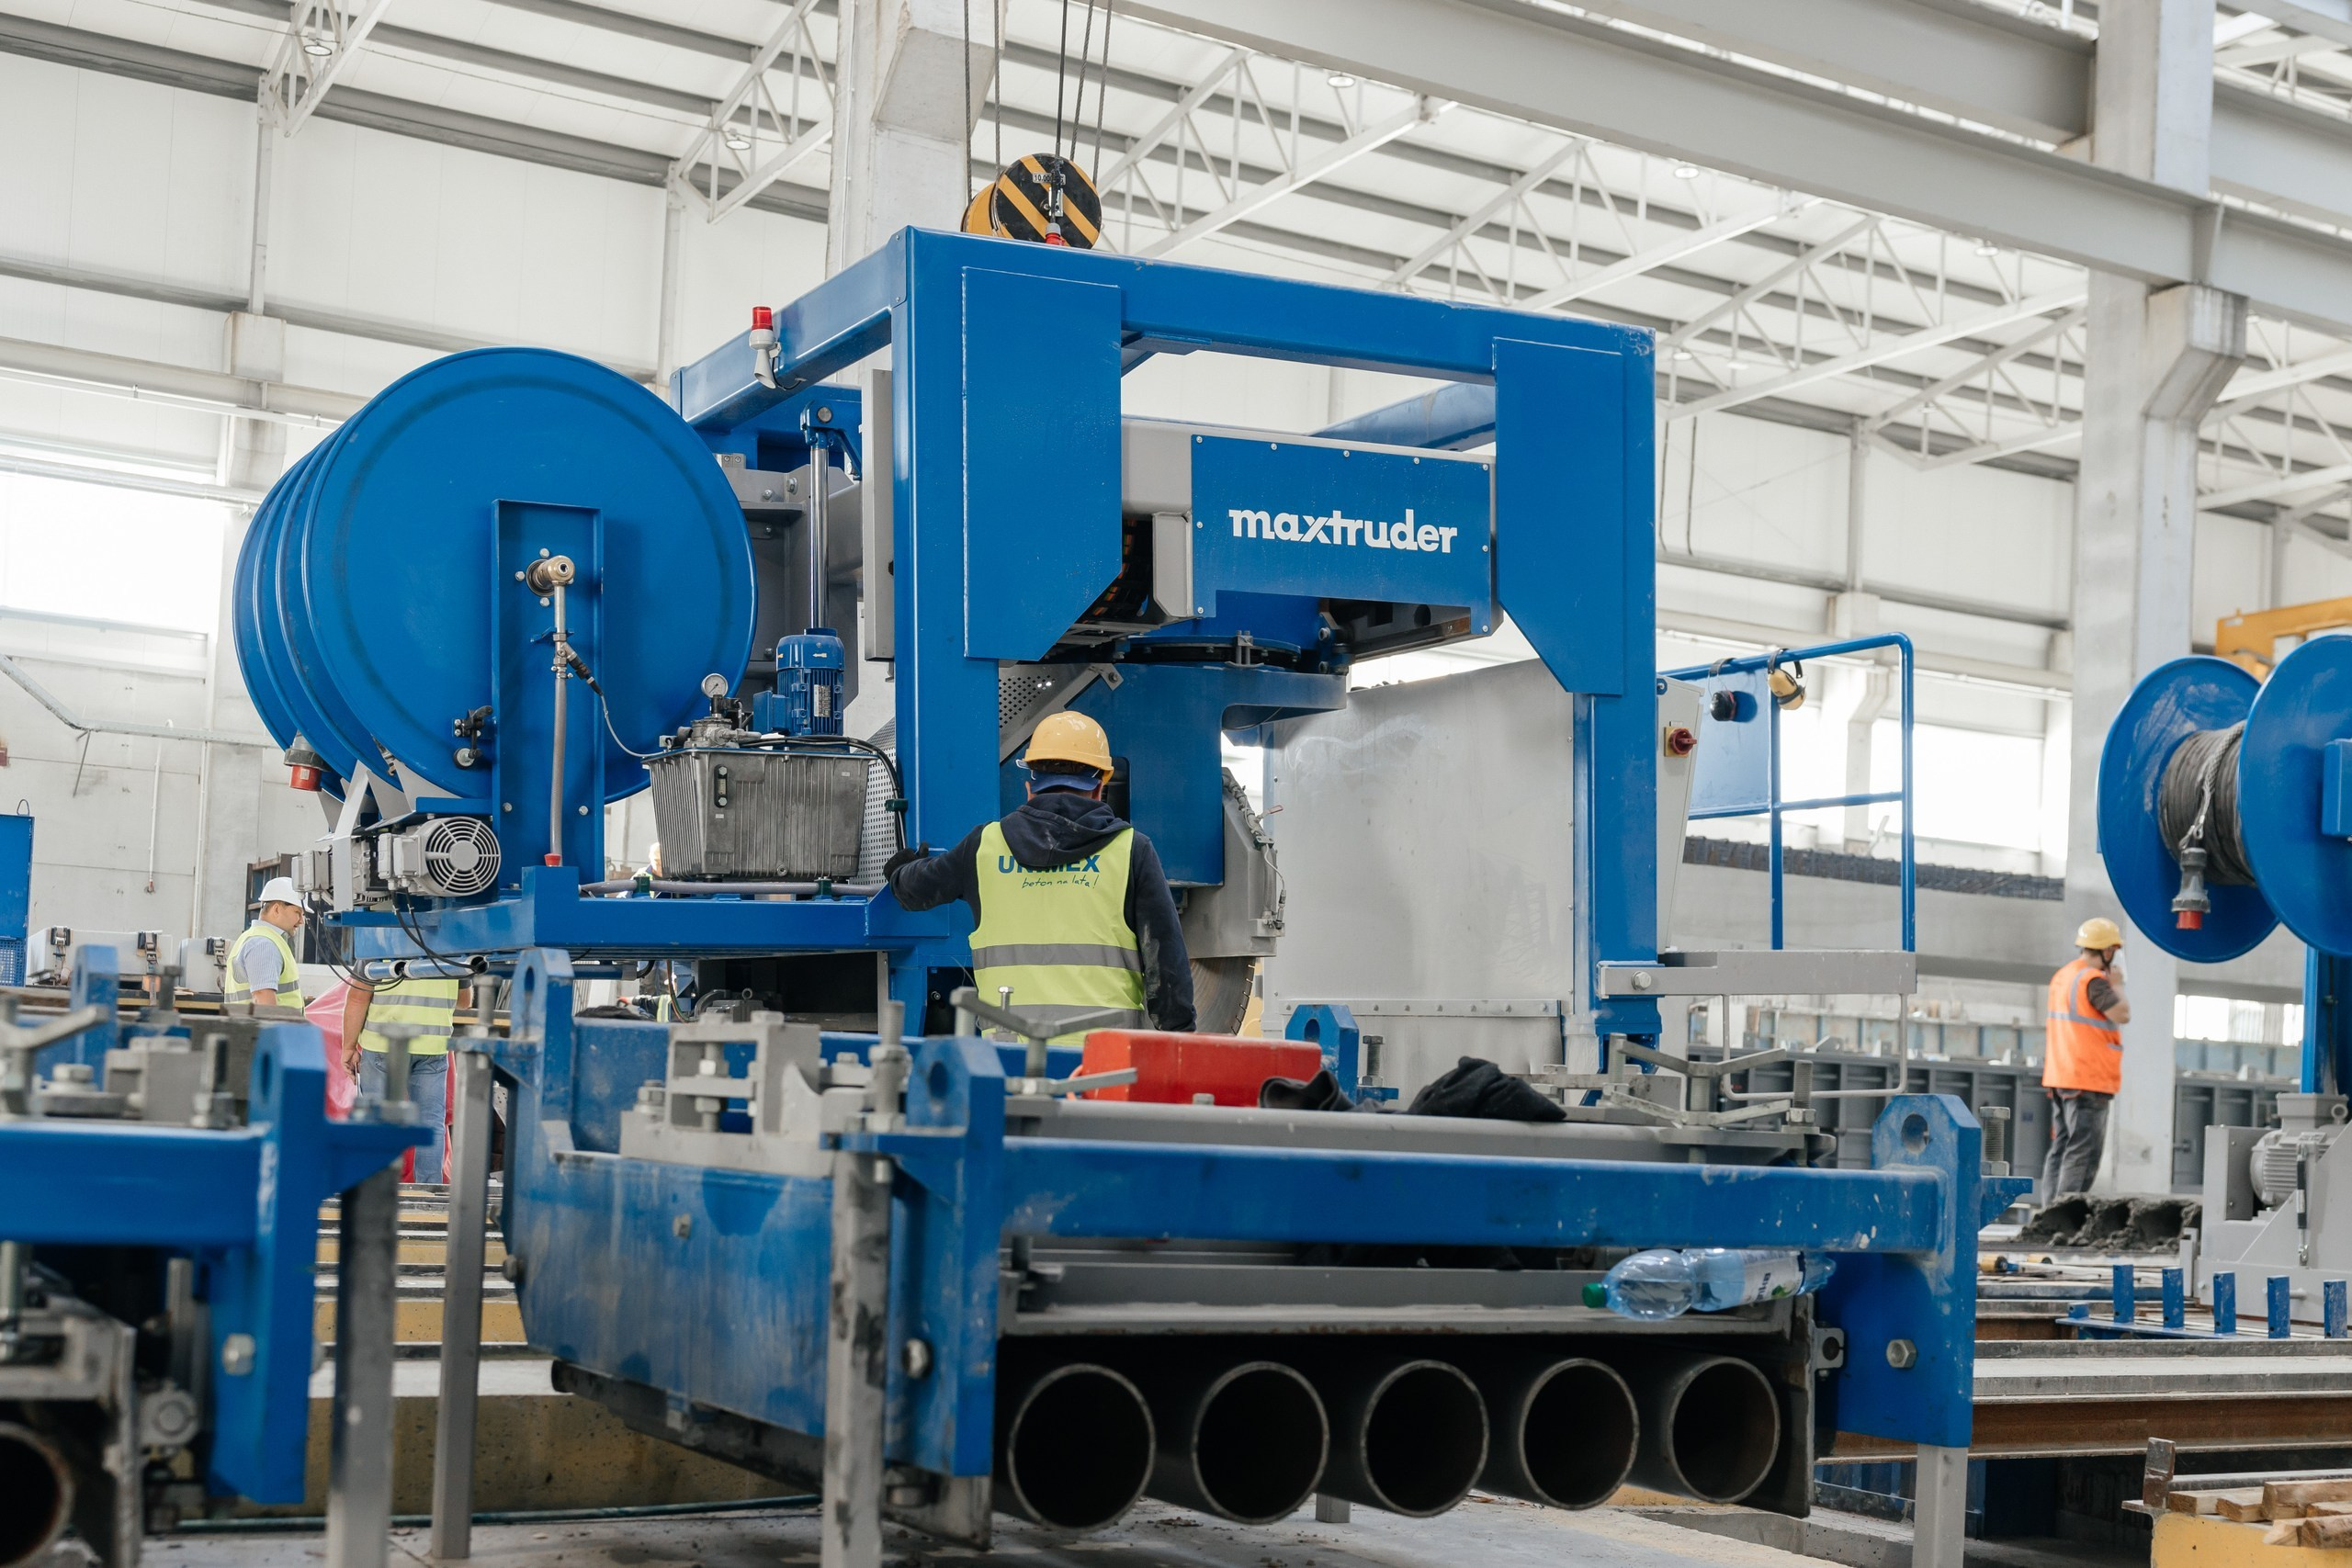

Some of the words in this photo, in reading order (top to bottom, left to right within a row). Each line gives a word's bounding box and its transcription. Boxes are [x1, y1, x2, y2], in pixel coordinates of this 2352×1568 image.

[1228, 508, 1457, 553] maxtruder
[998, 855, 1101, 874] UEX
[1022, 877, 1053, 889] beton
